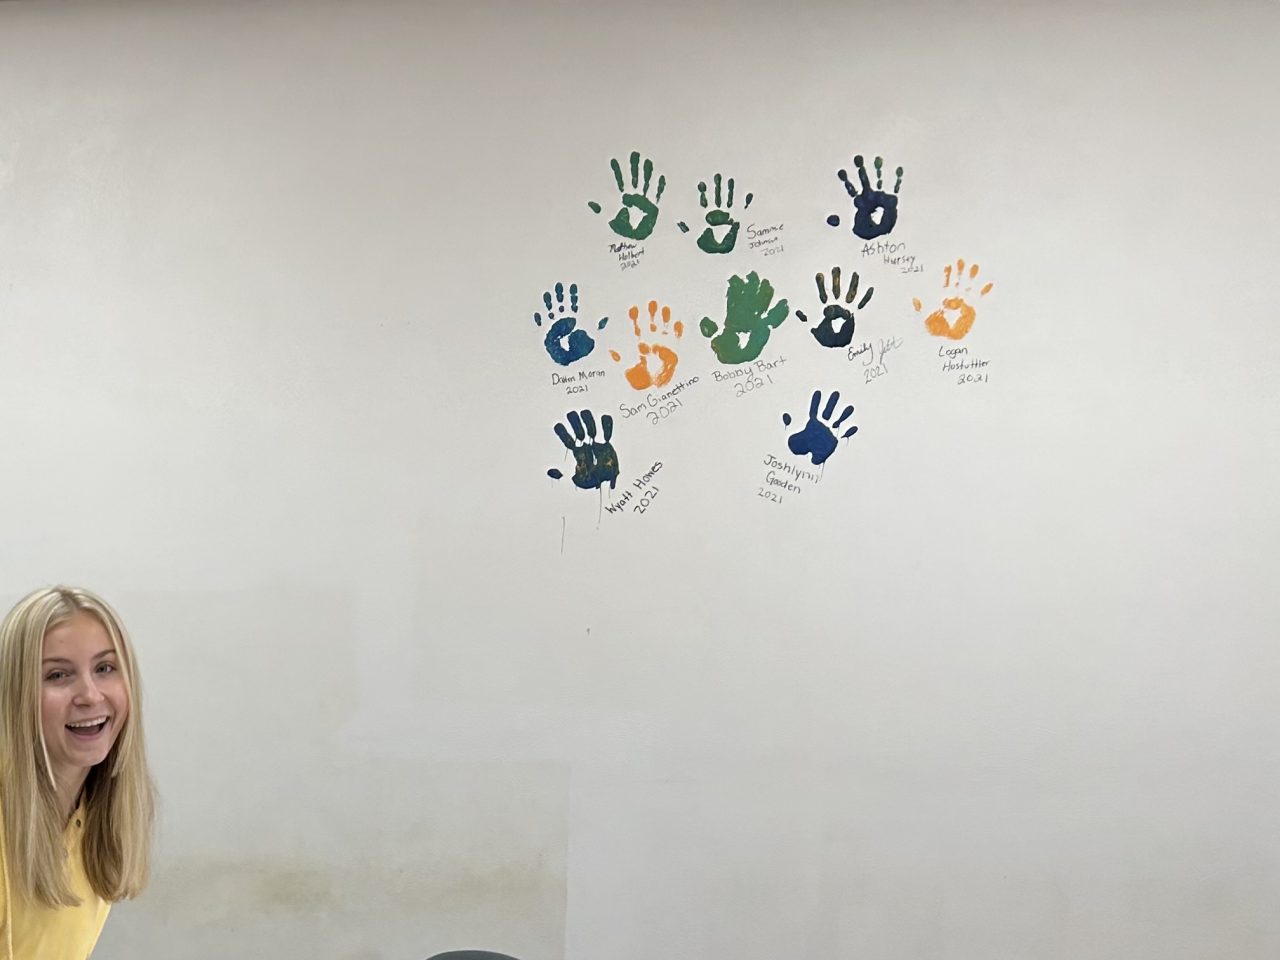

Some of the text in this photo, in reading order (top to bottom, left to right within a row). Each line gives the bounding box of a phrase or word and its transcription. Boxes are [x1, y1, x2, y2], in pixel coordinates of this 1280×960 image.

[861, 241, 906, 258] Ashton
[848, 342, 874, 367] Emily
[938, 345, 969, 359] Logan
[863, 364, 889, 384] 2021
[957, 373, 988, 385] 2021
[565, 384, 588, 395] 2021
[734, 374, 774, 397] 2021
[619, 402, 646, 419] Sam
[645, 400, 683, 426] 2021
[604, 490, 633, 514] Wyatt
[633, 486, 660, 514] 2021
[757, 487, 783, 504] 2021
